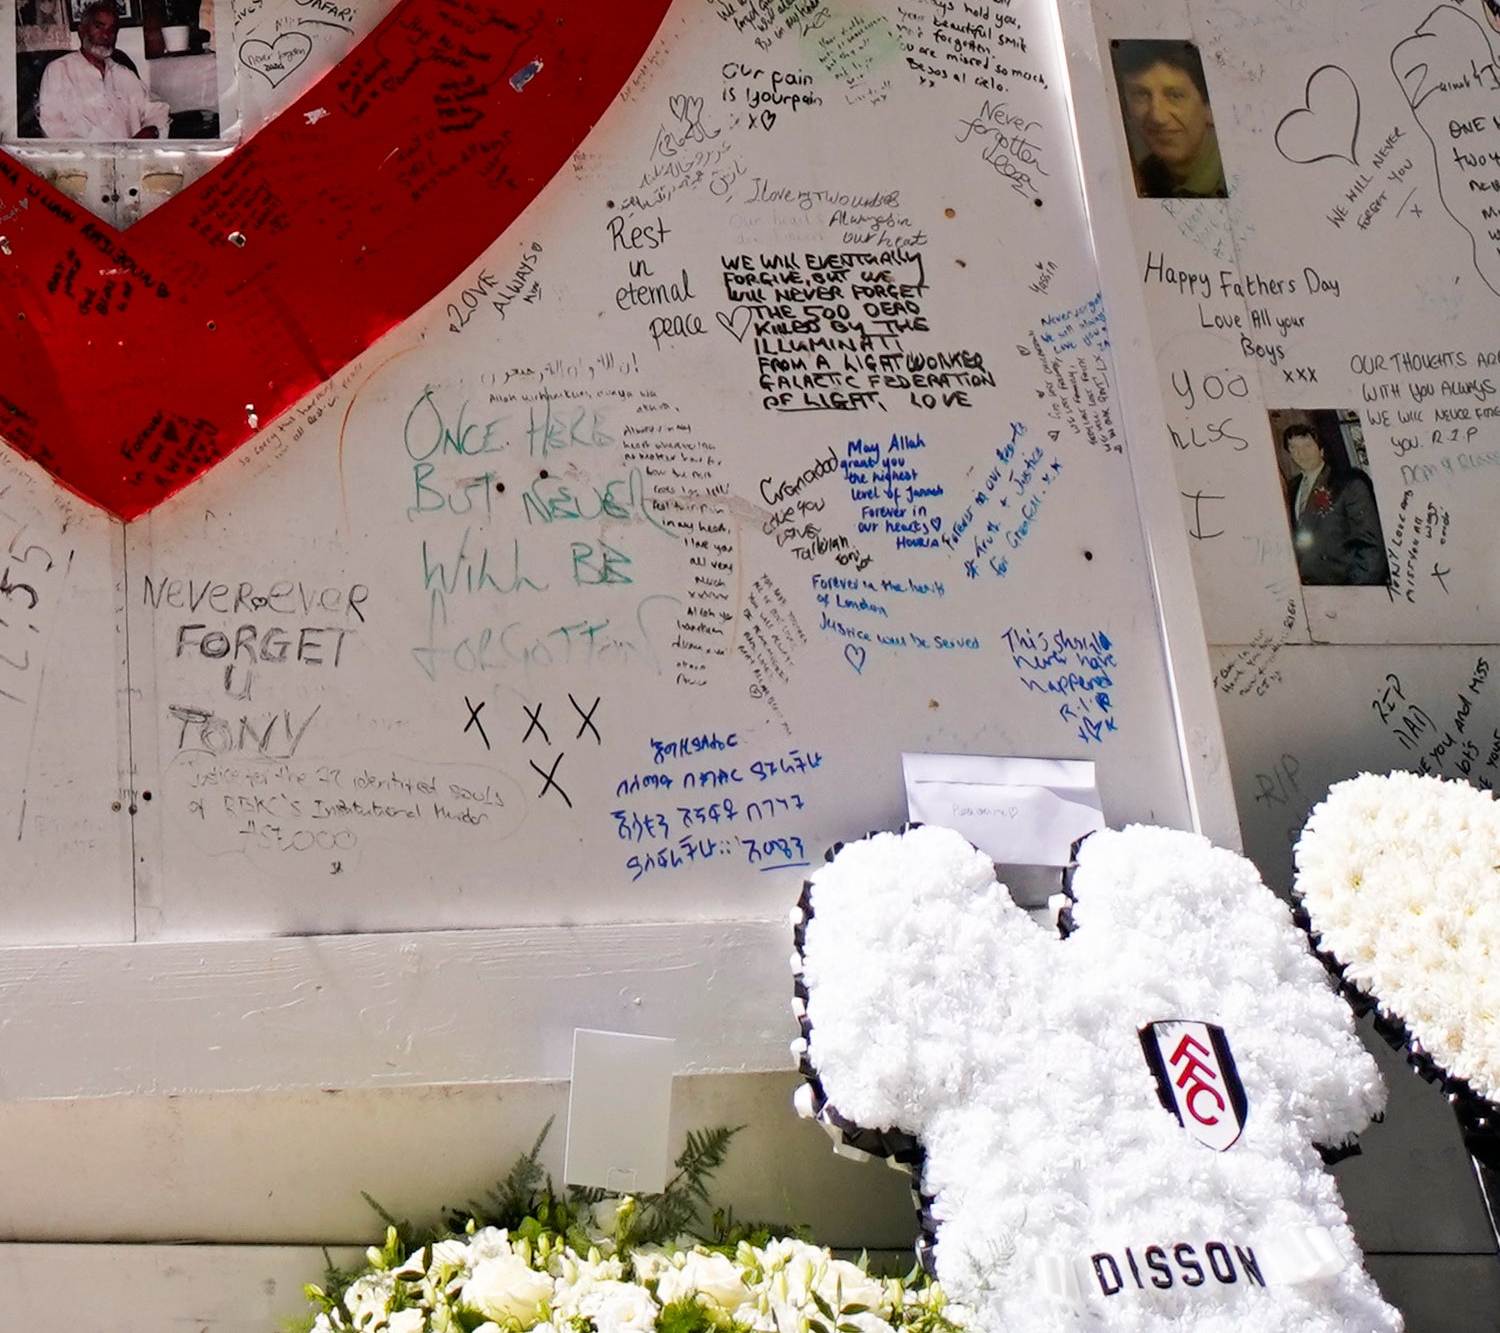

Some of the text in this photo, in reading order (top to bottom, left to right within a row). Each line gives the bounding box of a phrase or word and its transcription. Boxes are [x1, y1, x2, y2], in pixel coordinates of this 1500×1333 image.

[608, 217, 671, 253] Rest
[630, 258, 654, 277] in
[1145, 251, 1340, 299] Happy Fathers Day
[615, 272, 697, 308] eternal
[649, 314, 708, 347] peace
[1199, 308, 1305, 344] Love All your
[1239, 333, 1285, 361] Boys
[1169, 1034, 1225, 1126] FFC
[1091, 1241, 1266, 1296] DISSON
